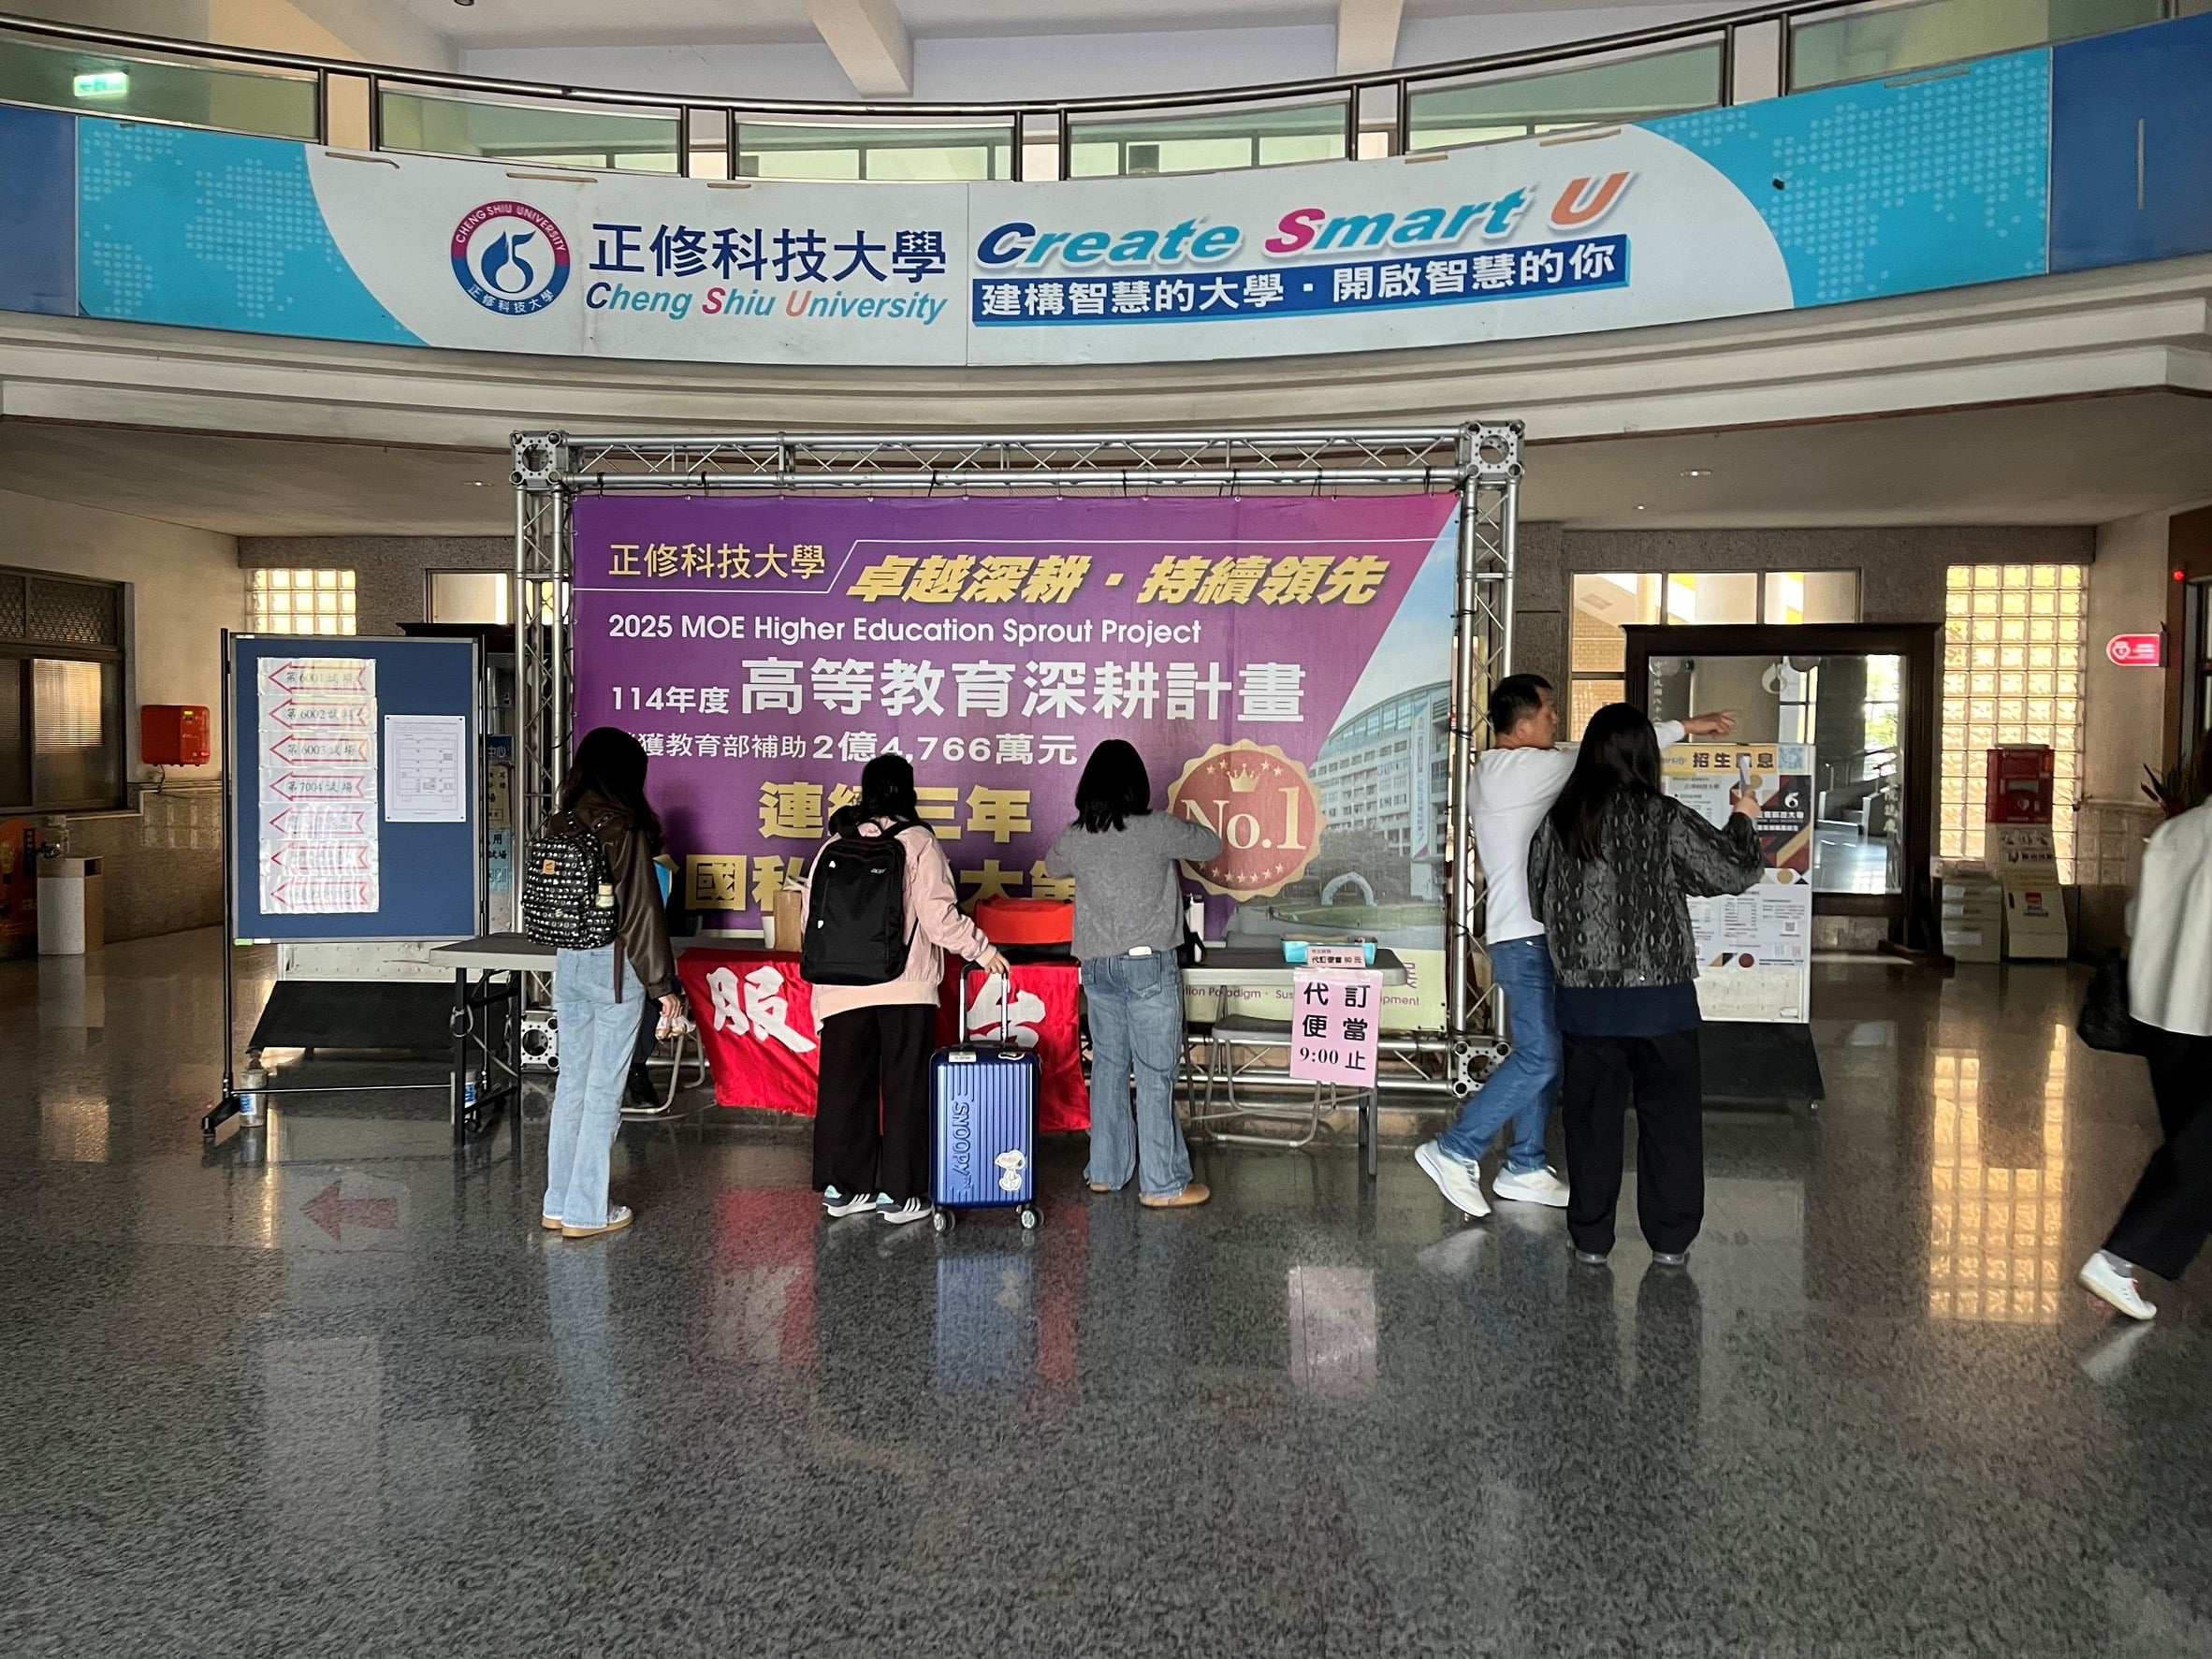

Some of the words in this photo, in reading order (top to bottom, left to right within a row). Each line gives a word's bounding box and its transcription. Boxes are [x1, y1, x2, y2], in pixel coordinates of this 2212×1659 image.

[456, 211, 486, 243] CHENG
[487, 204, 512, 216] SHIU
[517, 206, 566, 251] UNIVERSITY
[978, 218, 1239, 265] Create
[1265, 187, 1527, 255] Smart
[1550, 172, 1630, 226] U
[589, 223, 947, 284] 正修科技大學
[468, 284, 553, 313] 正修科技大學
[586, 282, 692, 320] Cheng
[702, 286, 776, 317] Shiu
[785, 289, 948, 326] University
[609, 543, 825, 579] 正修科技大學
[609, 615, 672, 638] 2025
[682, 616, 744, 638] MOE
[755, 617, 845, 646] Higher
[854, 617, 994, 642] Education
[1003, 619, 1092, 647] Sprout
[1102, 619, 1201, 648] Project
[613, 686, 730, 714] 114年度
[742, 657, 1306, 721] 高等教育深耕計畫
[626, 733, 807, 759] 獲教育部補助
[1208, 987, 1260, 999] Paadigm
